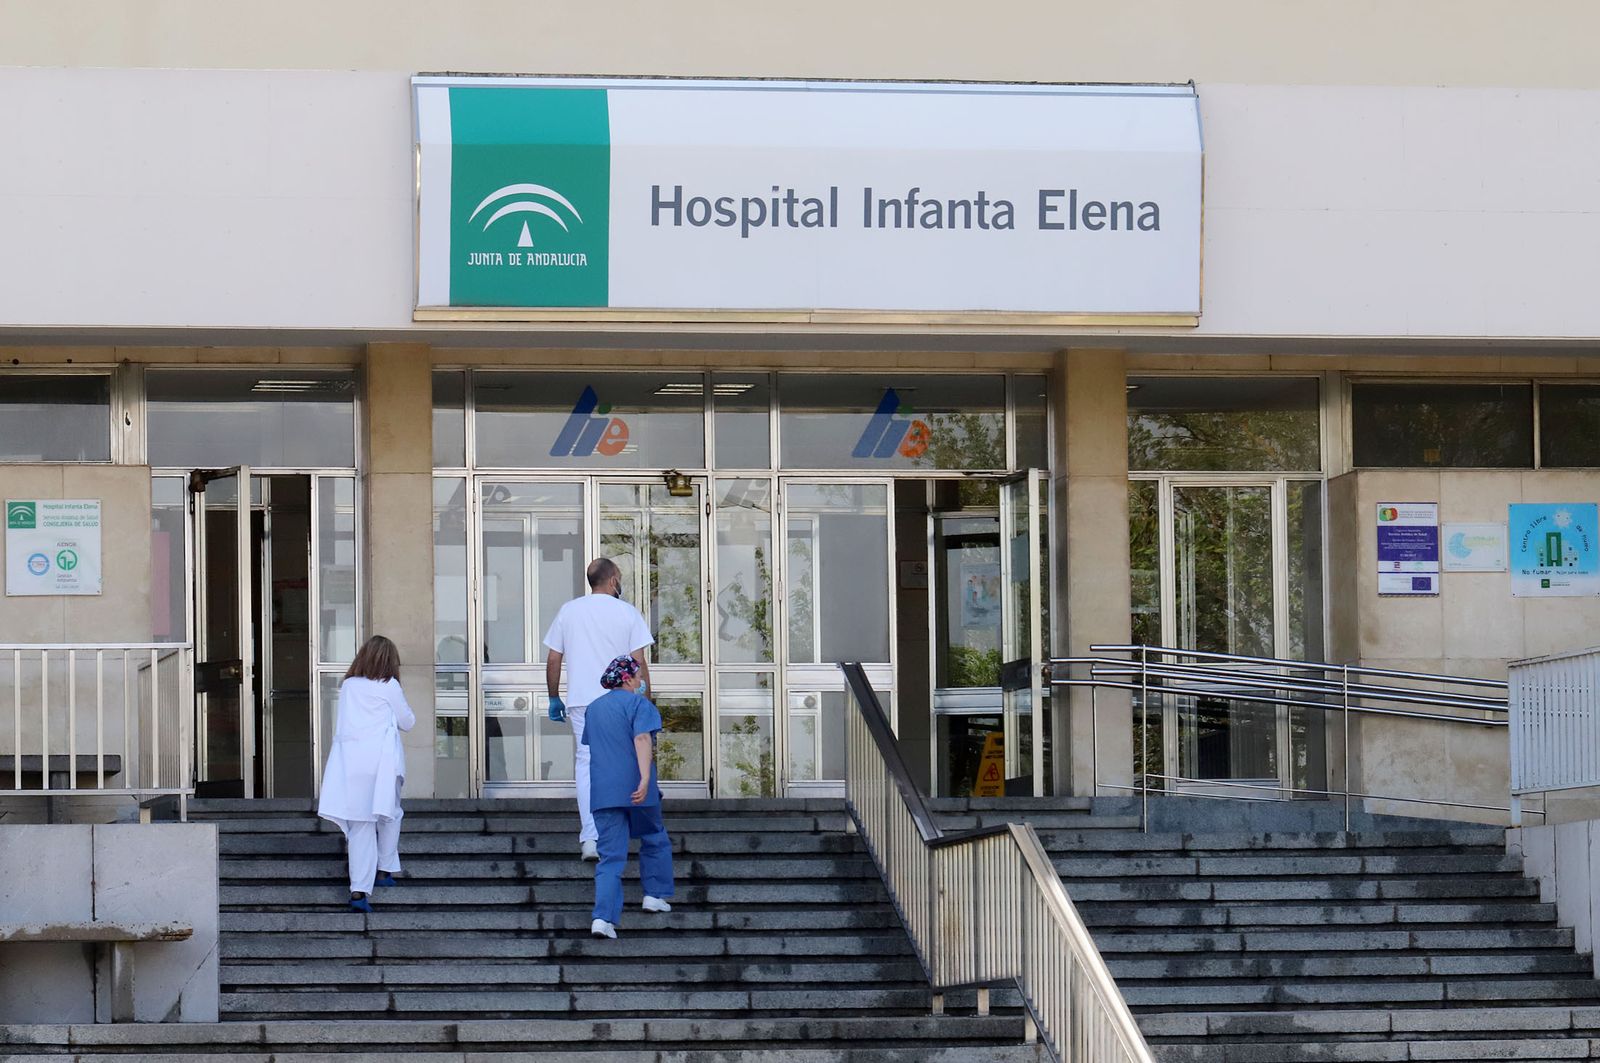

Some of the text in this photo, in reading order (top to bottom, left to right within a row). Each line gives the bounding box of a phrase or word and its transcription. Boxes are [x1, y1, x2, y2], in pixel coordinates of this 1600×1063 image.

[652, 185, 1161, 238] Hospital Infanta Elena
[467, 252, 503, 266] JUNTA
[509, 252, 521, 266] DE
